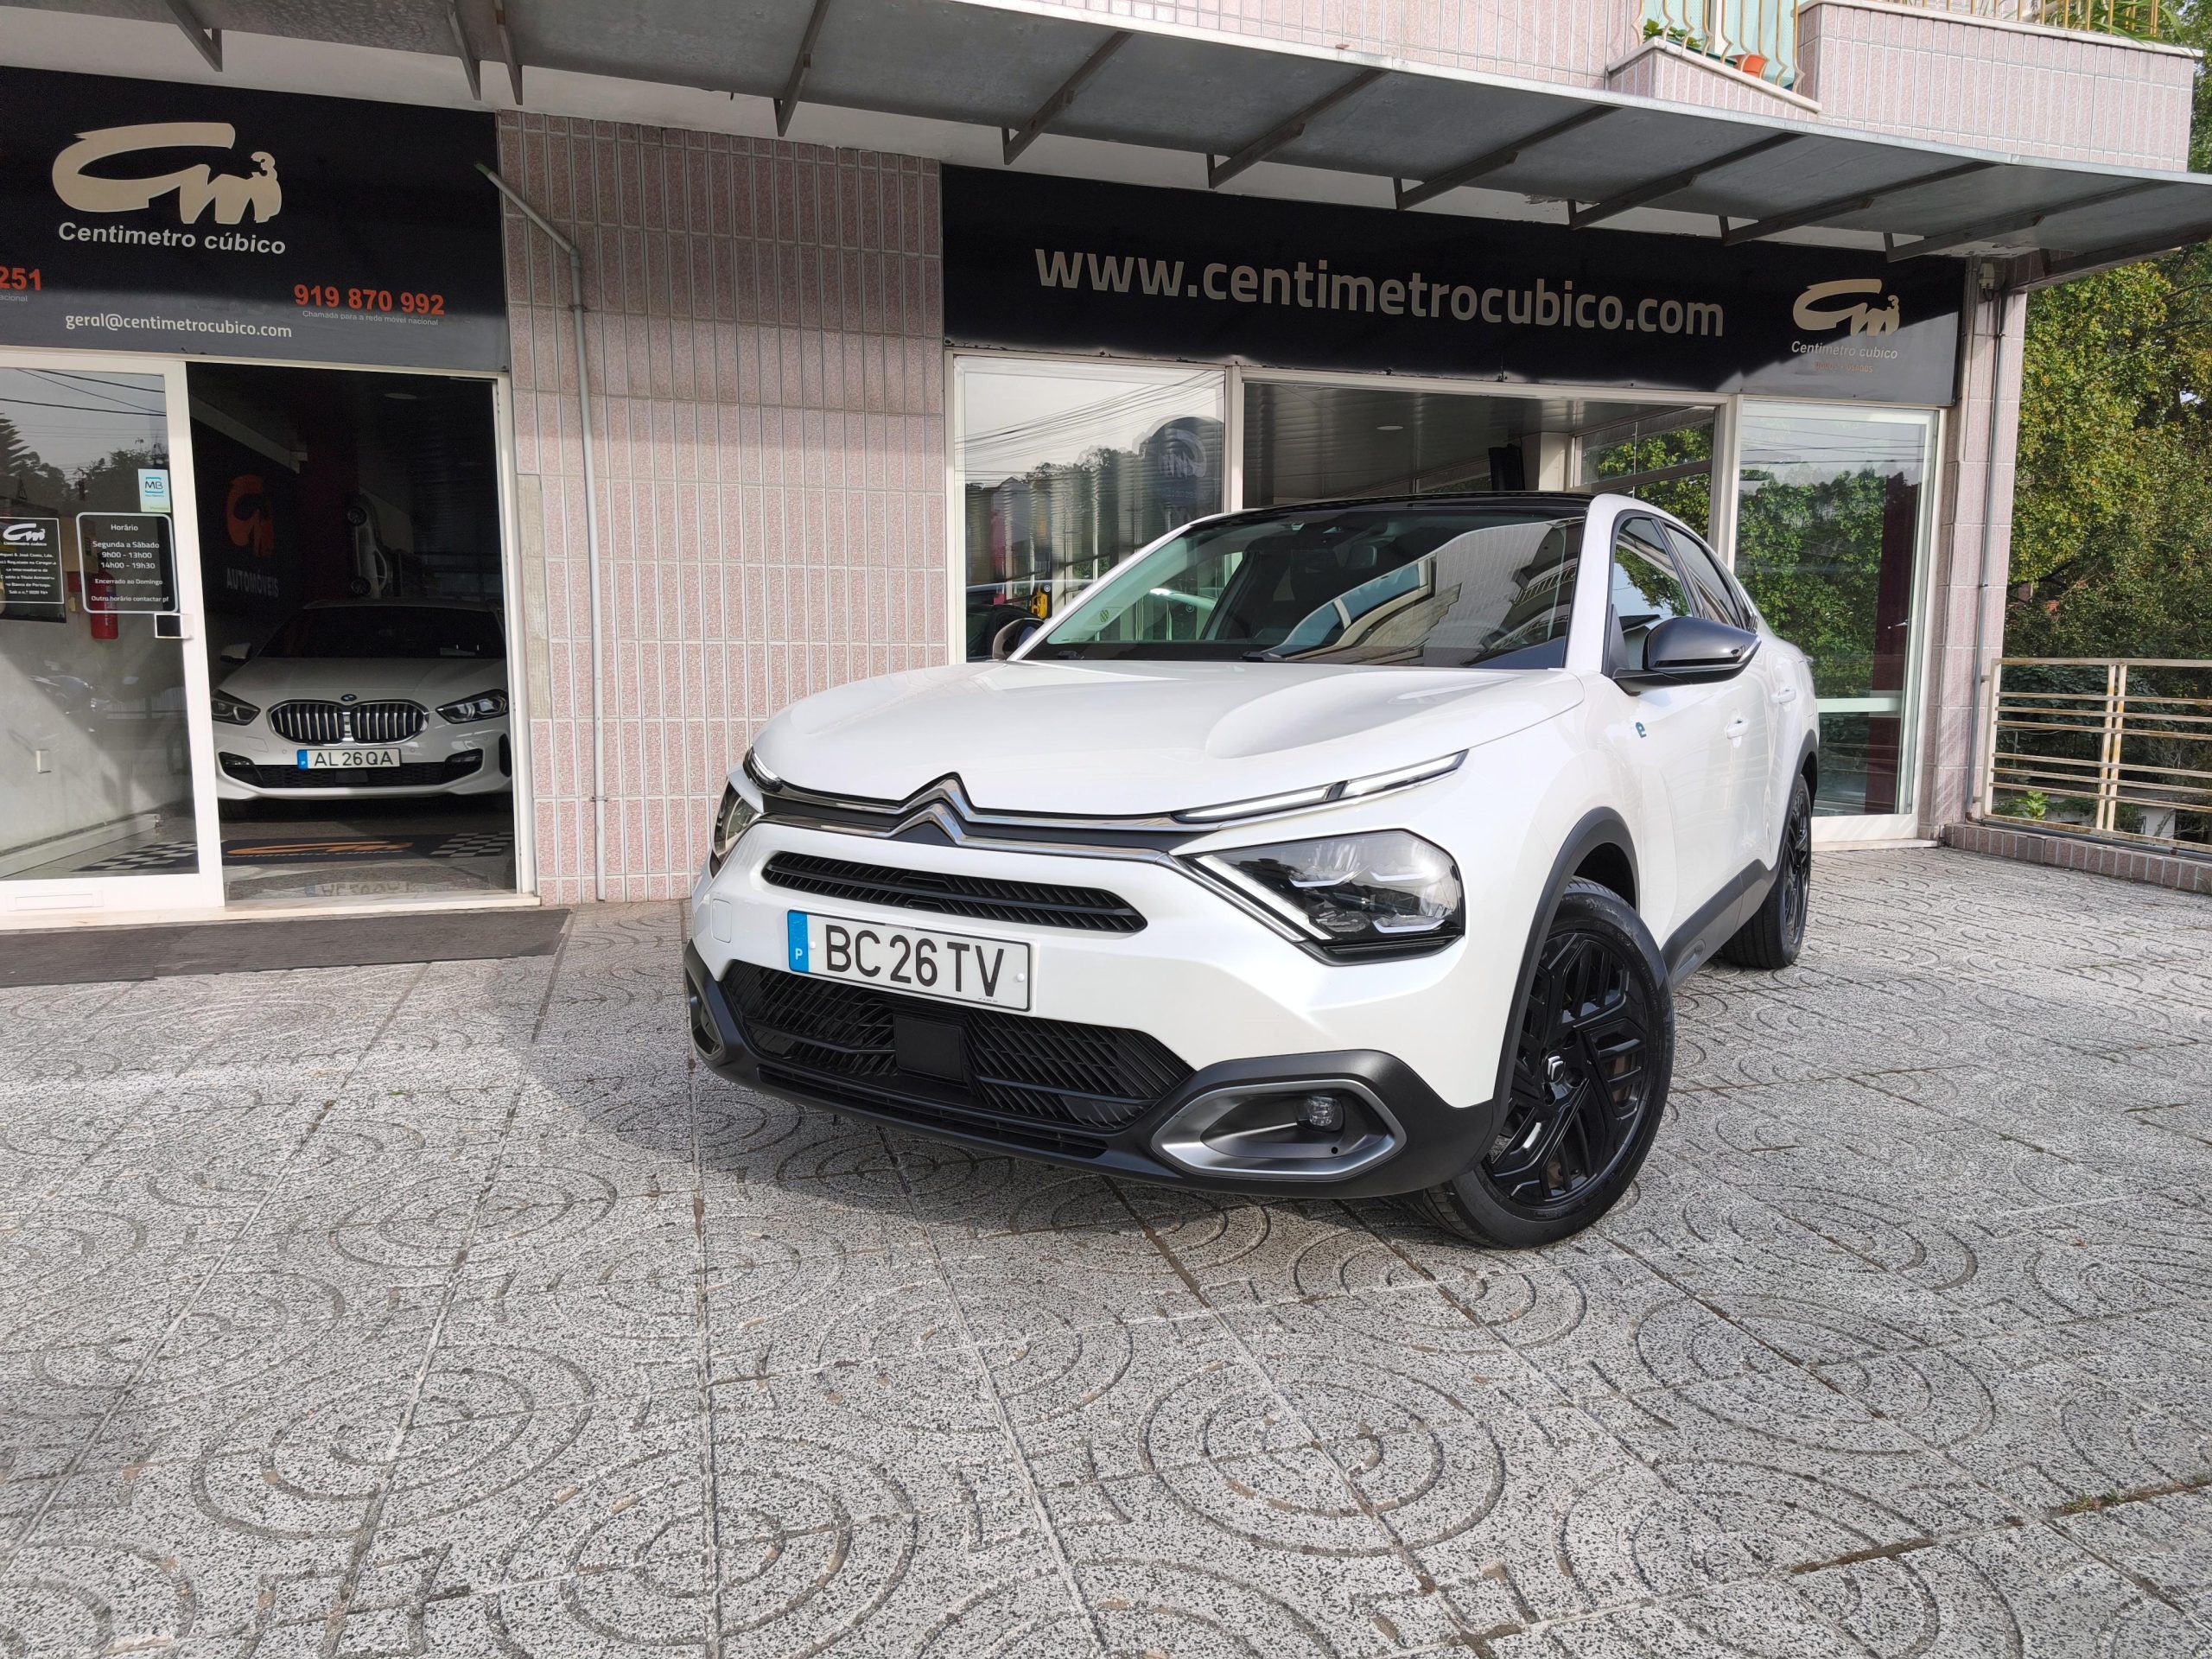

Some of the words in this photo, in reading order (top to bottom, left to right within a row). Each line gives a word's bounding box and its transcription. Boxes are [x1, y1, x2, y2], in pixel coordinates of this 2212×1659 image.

[58, 222, 196, 248] Centimetro
[204, 232, 286, 254] cúbico
[294, 283, 340, 308] 919
[348, 288, 392, 312] 870
[400, 292, 445, 315] 992
[1035, 248, 1724, 336] www.centimetrocubico.com
[65, 312, 292, 339] geral@centimetrocubico.com
[302, 310, 339, 319] Chamada
[1791, 340, 1856, 357] Centimetro
[145, 480, 163, 489] MB
[314, 752, 339, 766] AL
[341, 752, 363, 766] 26
[365, 751, 394, 766] QA
[825, 924, 881, 977] BC
[889, 934, 938, 988] 26
[946, 941, 1005, 997] TV
